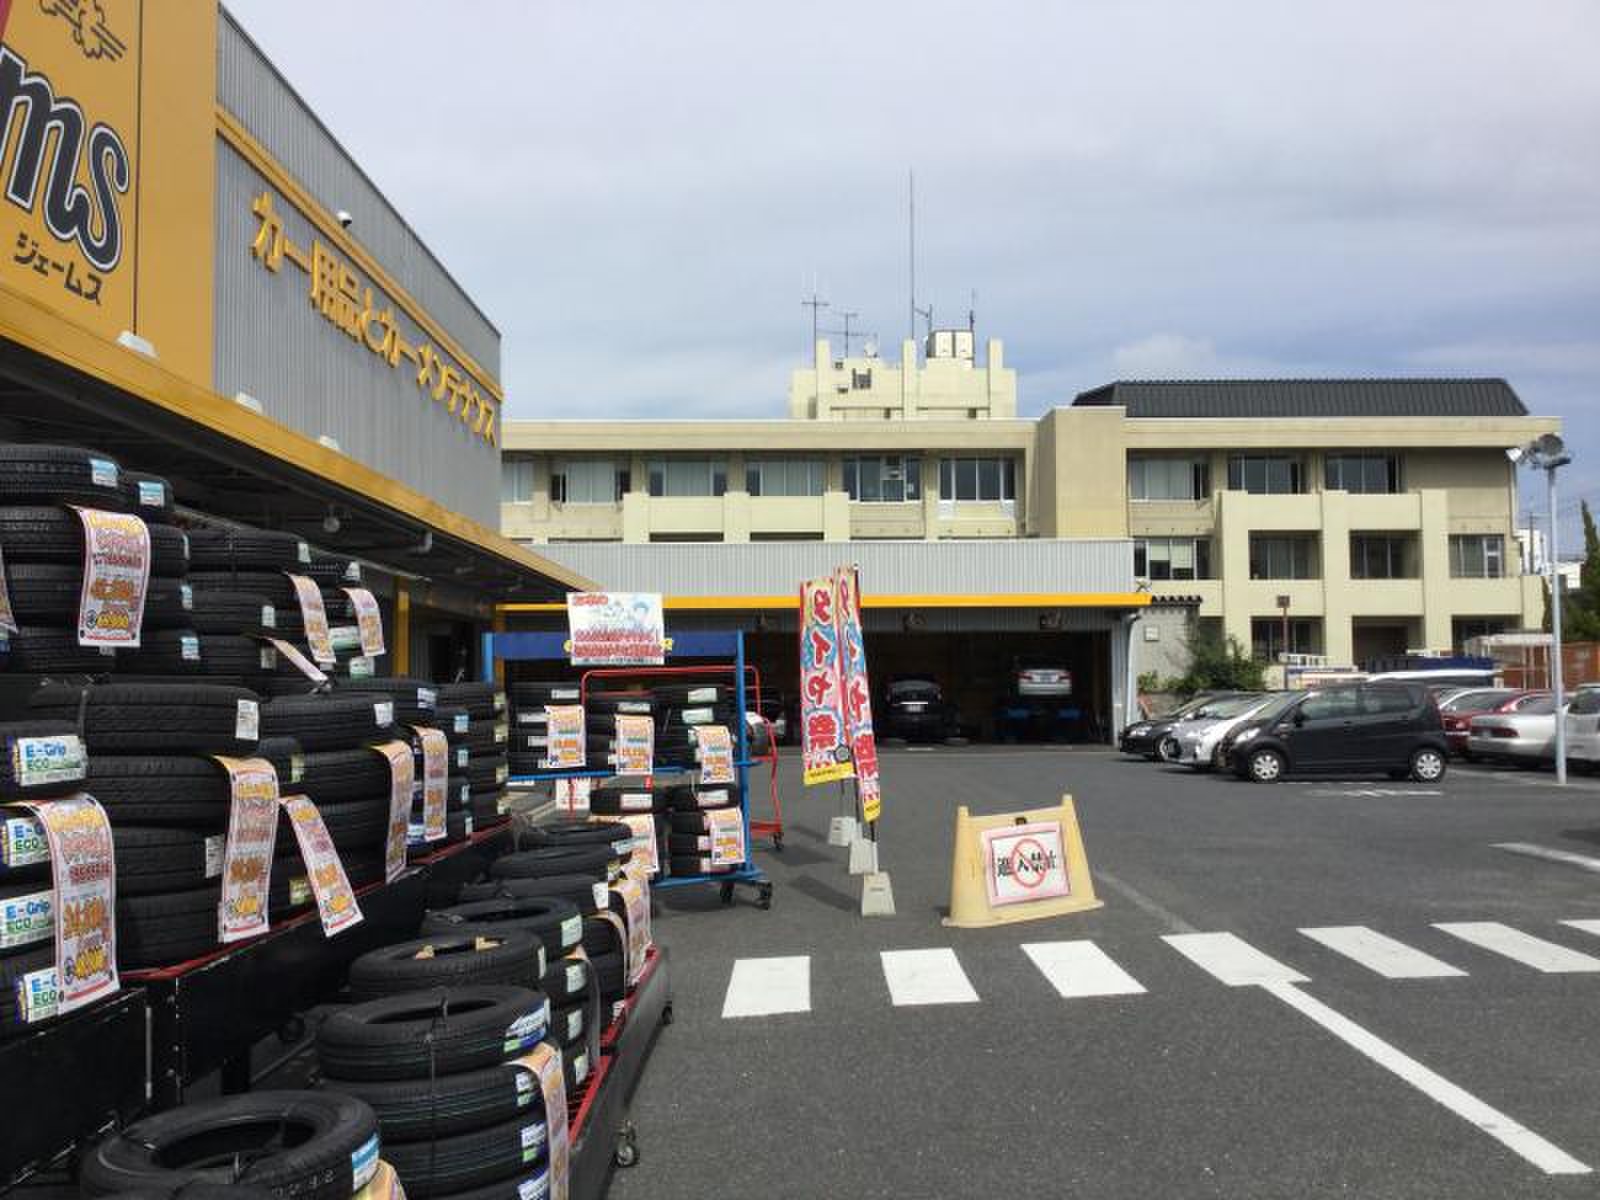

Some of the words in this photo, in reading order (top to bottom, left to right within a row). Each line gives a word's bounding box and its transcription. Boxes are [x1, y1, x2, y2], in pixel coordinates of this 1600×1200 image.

[14, 232, 103, 306] ジェームス
[251, 191, 498, 448] カー用品とカーメンテナンス
[33, 989, 57, 1006] ECO
